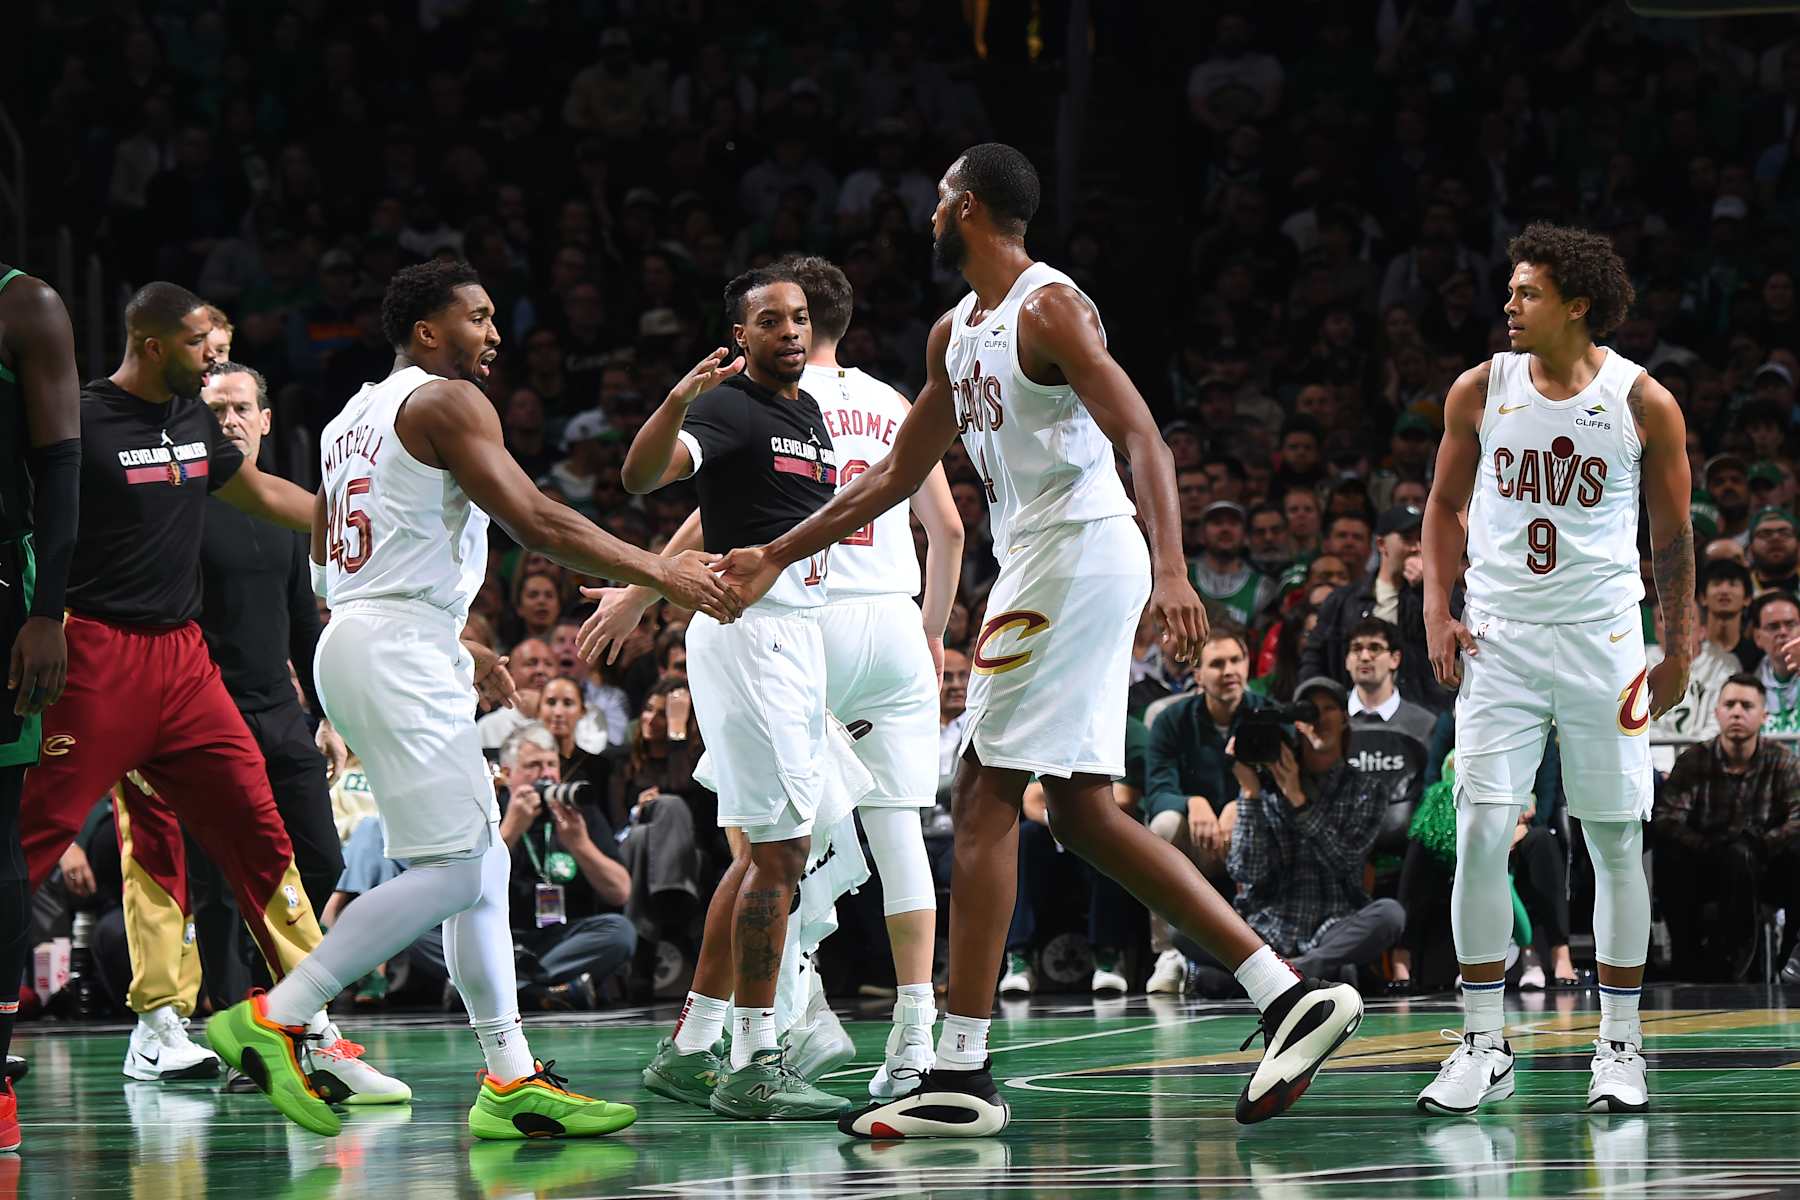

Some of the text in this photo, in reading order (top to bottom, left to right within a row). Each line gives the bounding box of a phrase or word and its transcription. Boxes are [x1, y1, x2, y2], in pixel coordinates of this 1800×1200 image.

[984, 340, 1007, 348] CLIFFS
[823, 409, 897, 446] EROME
[1575, 418, 1611, 430] CLIFFS
[118, 447, 172, 467] CLEVELAND
[324, 425, 383, 481] MITCHELL
[771, 437, 818, 461] CLEVELAND
[1494, 446, 1607, 508] CAVS
[329, 477, 373, 574] 45
[1526, 518, 1557, 575] 9
[1347, 750, 1405, 772] eltics
